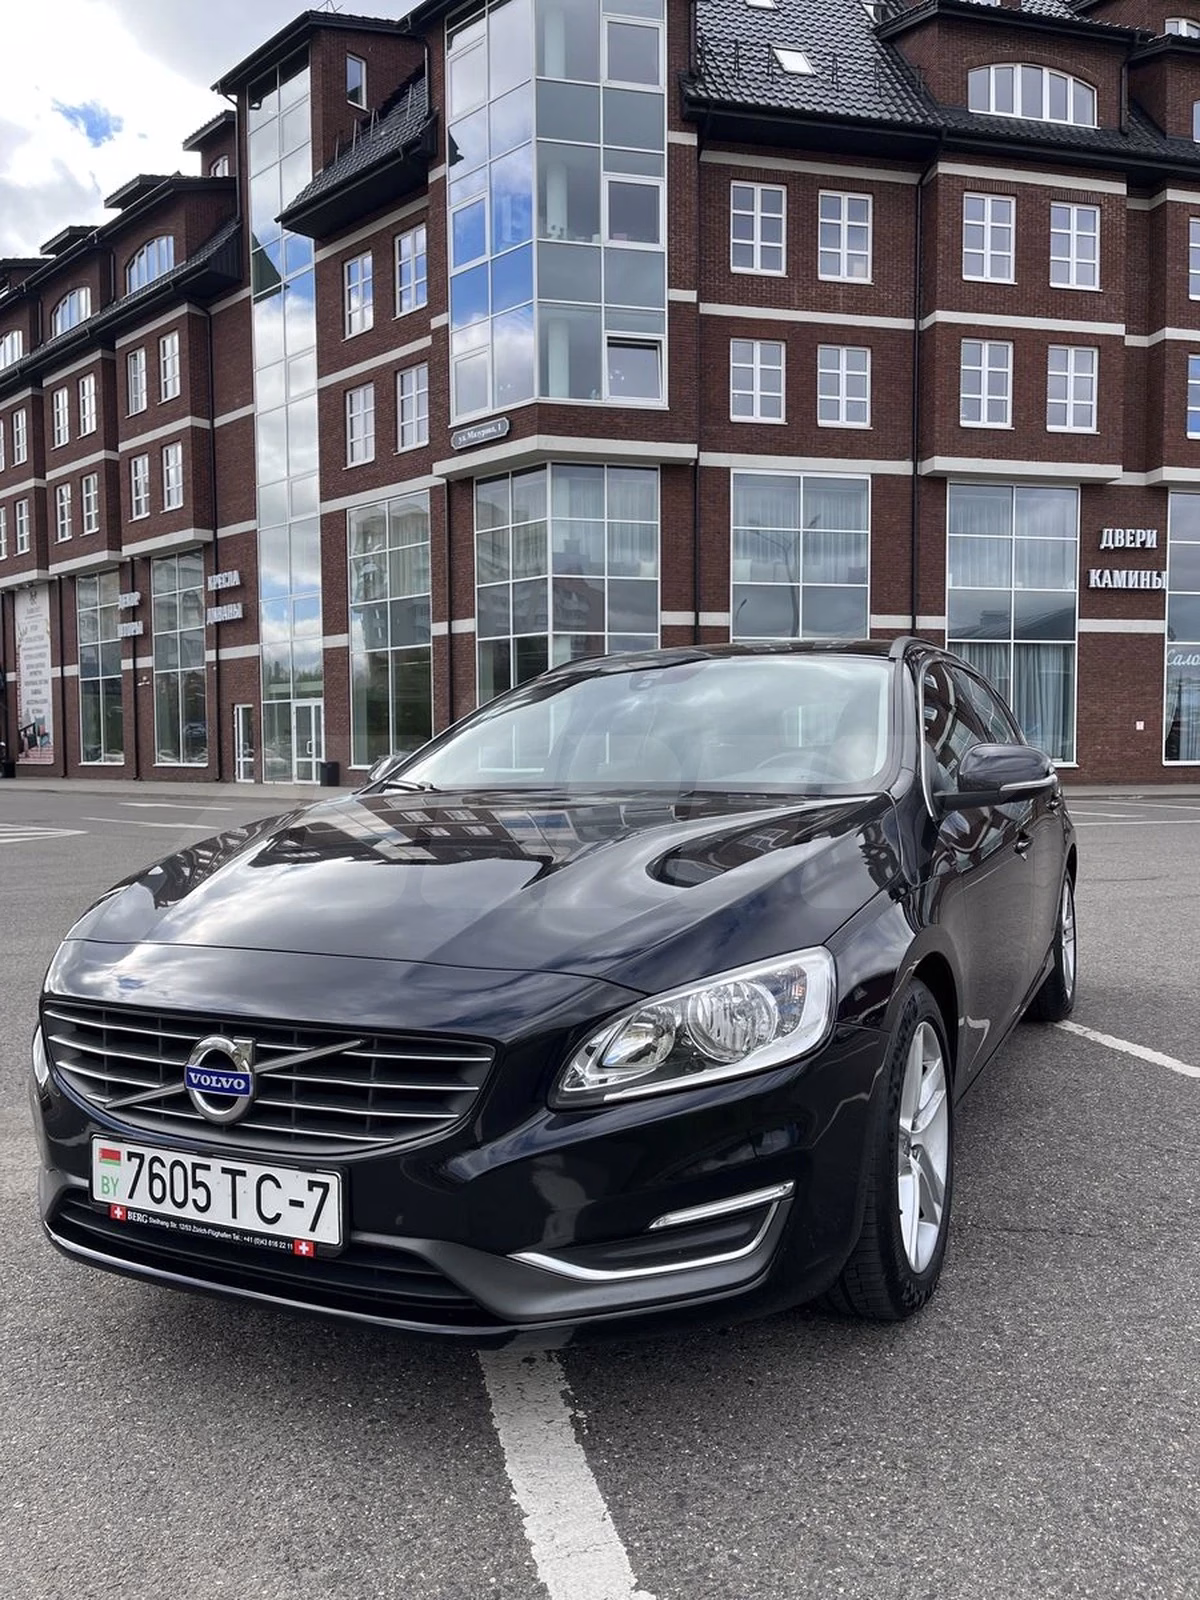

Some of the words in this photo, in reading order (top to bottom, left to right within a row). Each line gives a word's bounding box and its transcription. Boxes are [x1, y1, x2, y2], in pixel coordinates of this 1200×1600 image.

[1100, 528, 1158, 549] ДВЕРИ
[1088, 568, 1168, 589] КАМИНЫ
[188, 1071, 246, 1090] VOLVO
[101, 1175, 120, 1197] BY
[127, 1210, 149, 1224] BERG
